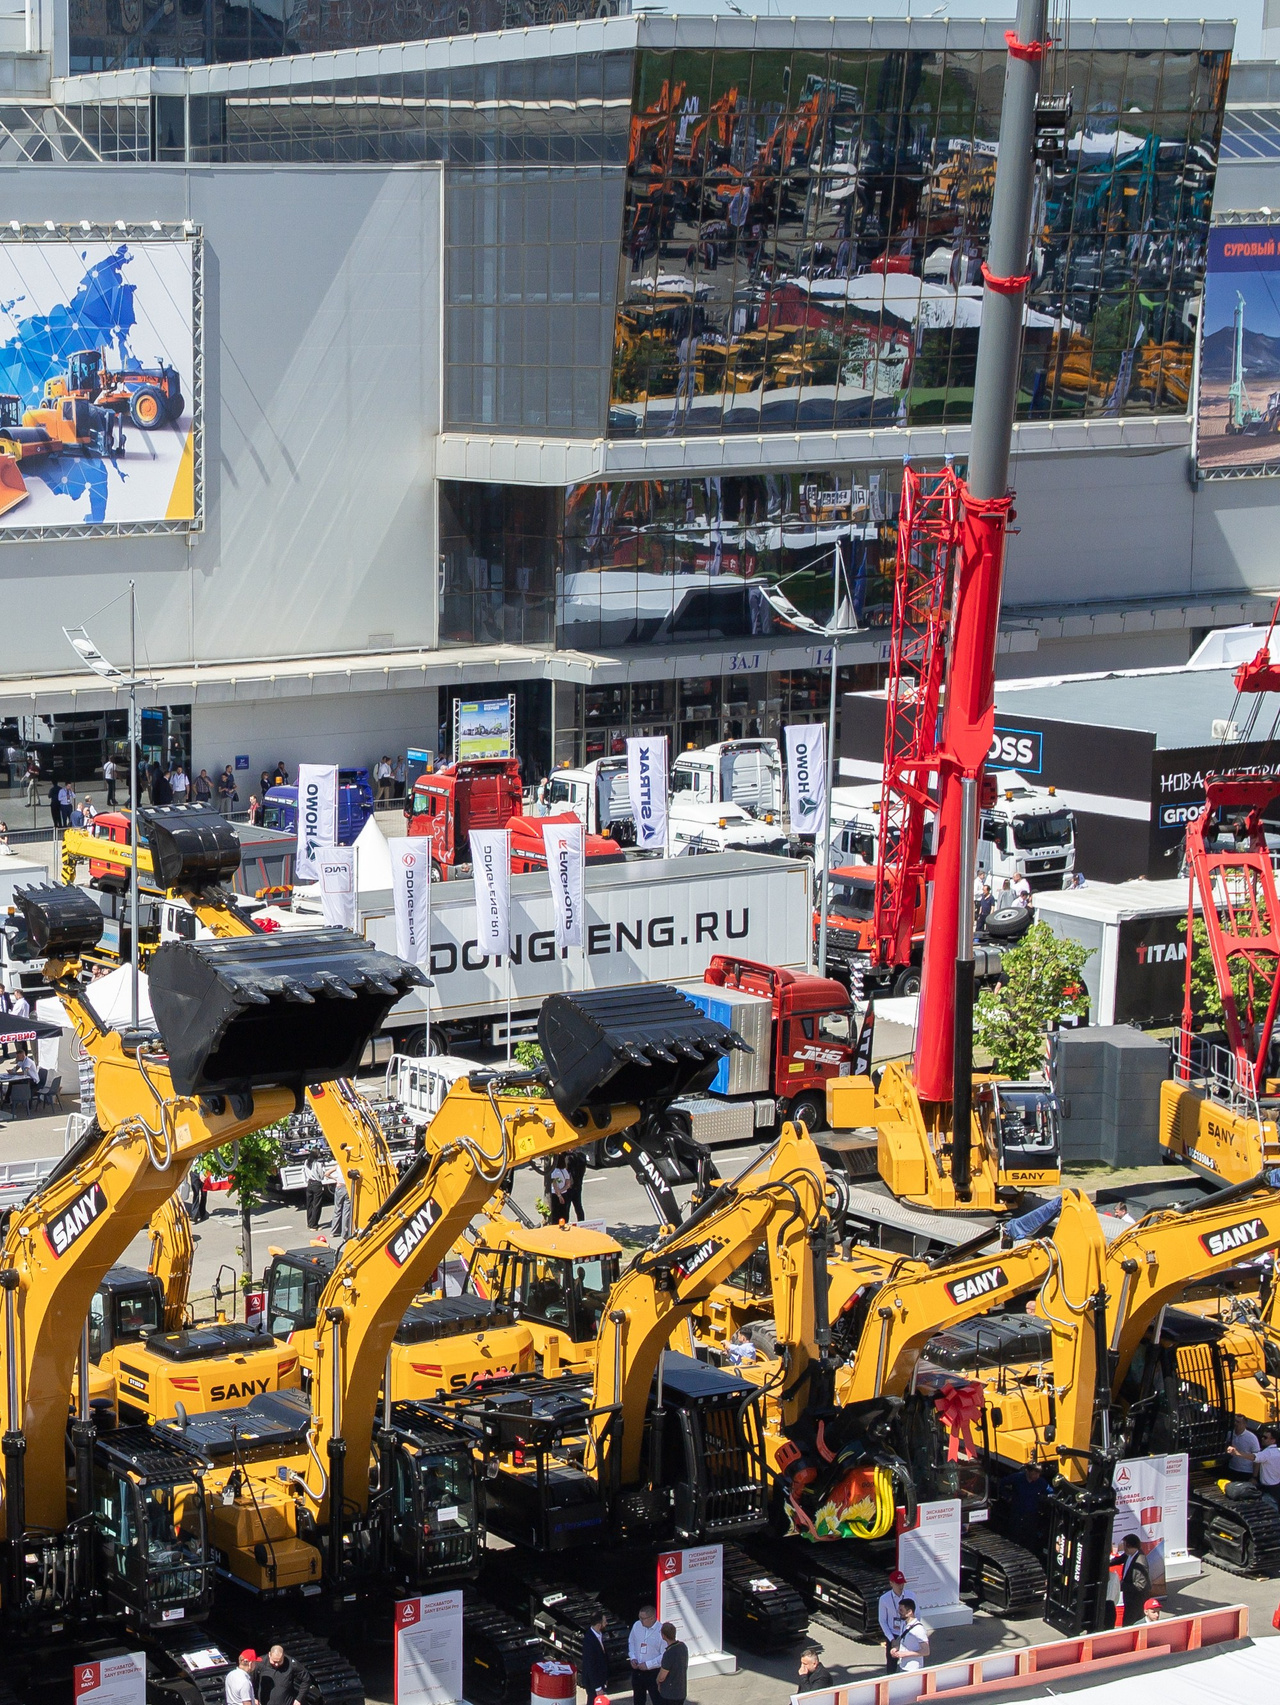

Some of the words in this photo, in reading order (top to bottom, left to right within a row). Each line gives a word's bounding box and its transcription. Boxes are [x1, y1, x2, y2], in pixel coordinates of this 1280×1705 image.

[1224, 238, 1275, 257] СУРОВЫЙ
[728, 654, 760, 671] ЗАЛ
[815, 648, 833, 665] 14
[987, 734, 1033, 764] OSS
[430, 907, 750, 976] DONGENG.RU
[1208, 1121, 1235, 1146] SANY
[638, 1151, 670, 1194] SANY
[1011, 1172, 1046, 1180] SANY
[53, 1185, 98, 1254] SANY
[394, 1200, 434, 1263] SANY
[1209, 1219, 1258, 1255] SANY
[686, 1240, 714, 1273] SANY
[953, 1267, 1000, 1304] SANY
[210, 1378, 271, 1402] SANY
